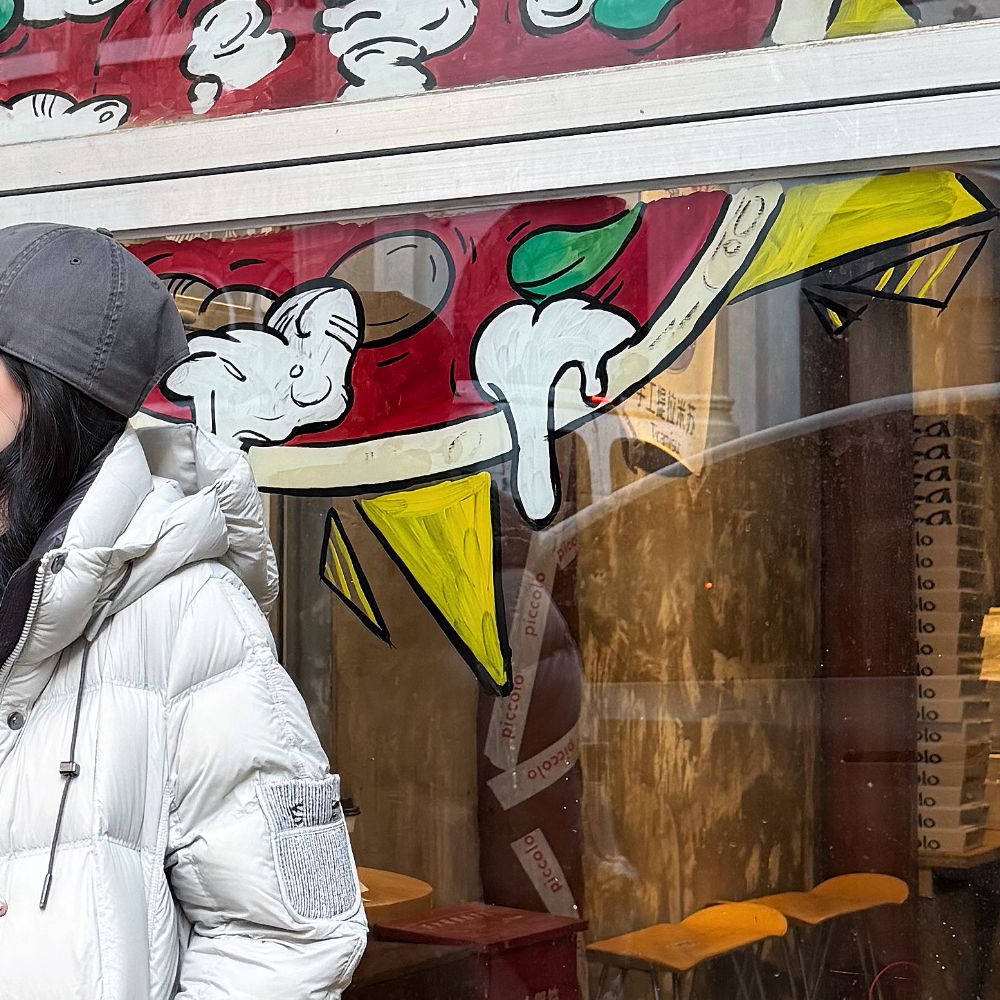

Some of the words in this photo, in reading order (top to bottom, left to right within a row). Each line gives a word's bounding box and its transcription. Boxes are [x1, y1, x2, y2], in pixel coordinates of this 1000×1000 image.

[524, 572, 545, 637] piccolo
[500, 674, 524, 740] piccolo
[528, 739, 575, 779] piccolo
[524, 835, 562, 893] piccolo
